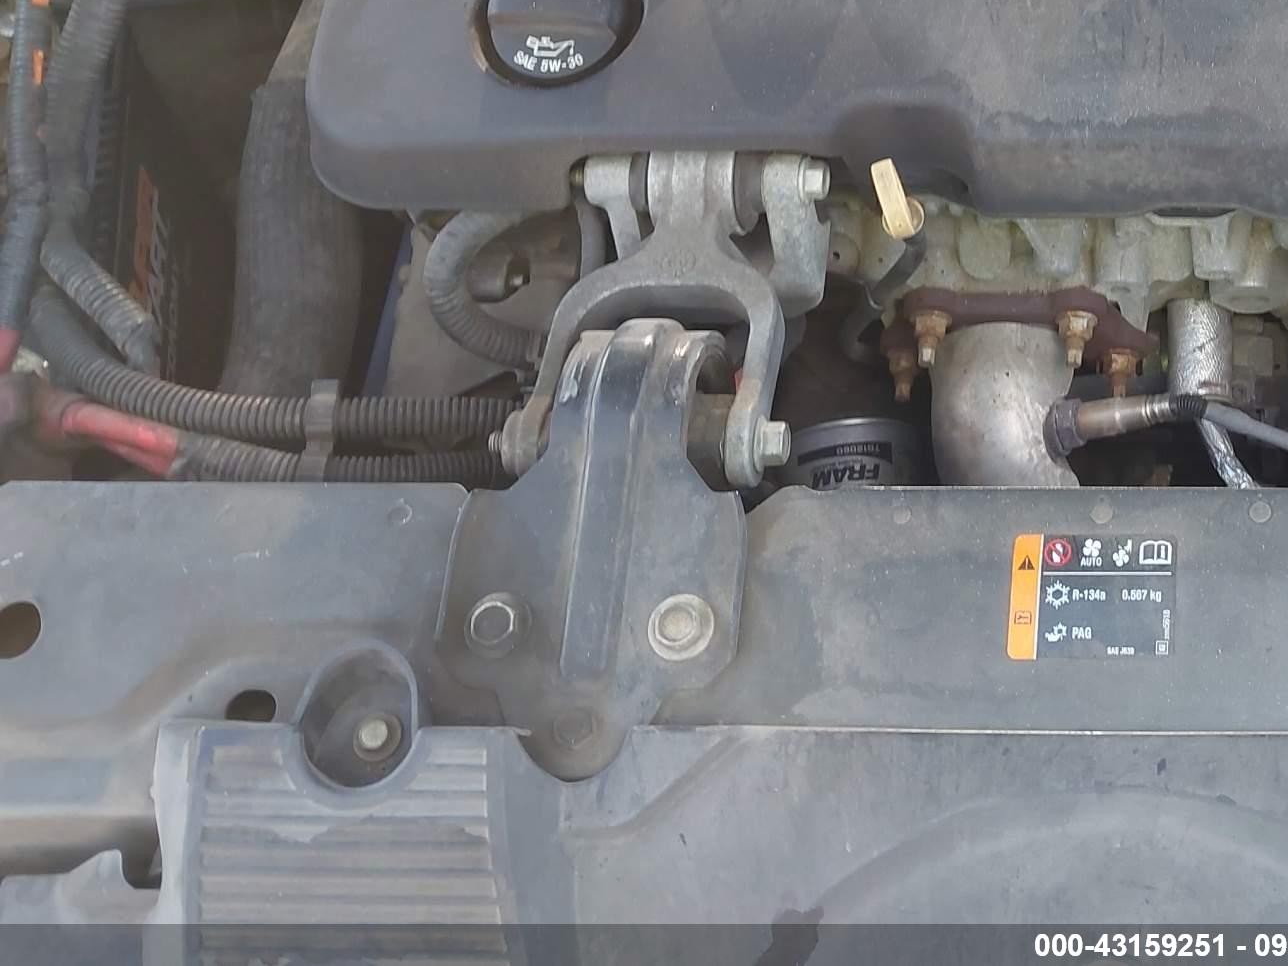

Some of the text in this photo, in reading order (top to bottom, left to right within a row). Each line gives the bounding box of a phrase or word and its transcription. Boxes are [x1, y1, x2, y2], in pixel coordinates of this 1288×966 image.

[513, 50, 584, 73] SAE 5W-30
[811, 464, 880, 489] FRAM
[1080, 556, 1103, 567] AUTO
[1072, 589, 1106, 601] R-134a
[1150, 589, 1162, 603] kg
[1072, 627, 1092, 640] PAG
